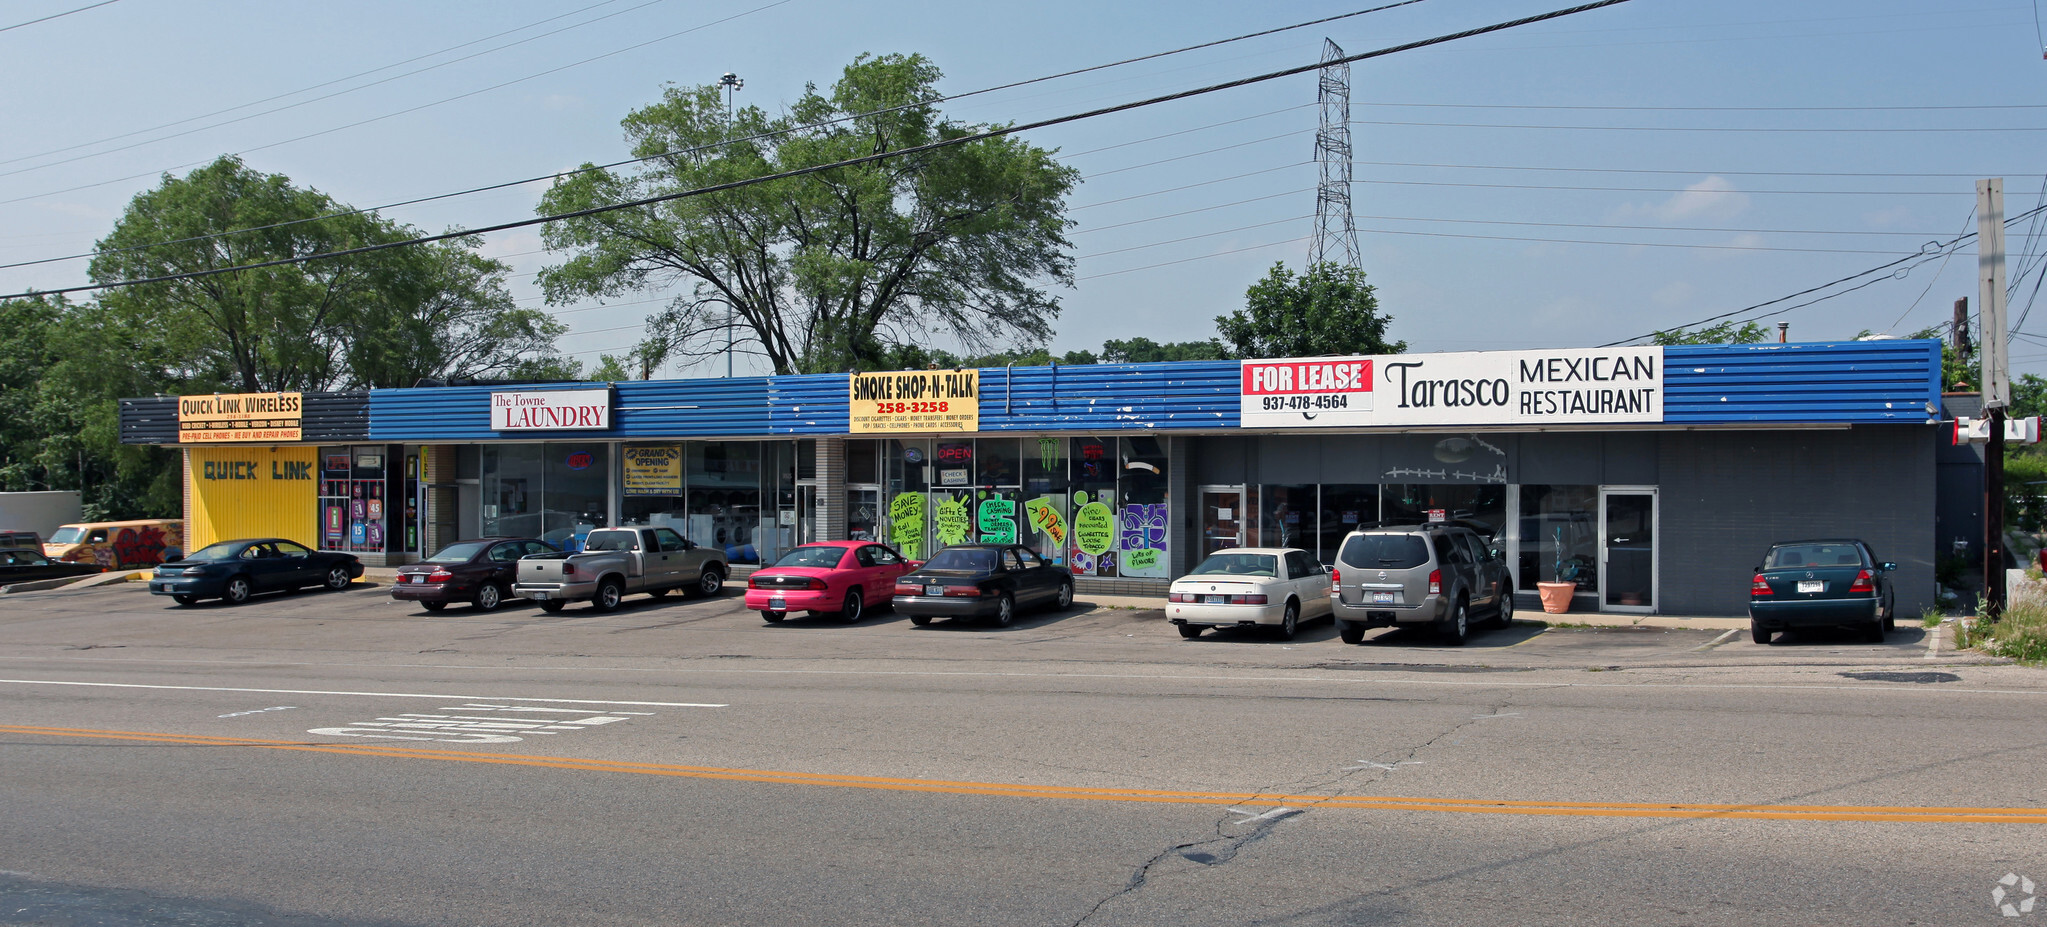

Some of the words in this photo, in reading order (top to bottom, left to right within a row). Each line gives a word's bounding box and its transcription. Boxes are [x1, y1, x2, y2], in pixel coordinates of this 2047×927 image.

[1252, 366, 1293, 392] FOR
[1298, 363, 1362, 391] LEASE
[1520, 355, 1654, 383] MEXICAN
[853, 376, 892, 401] SMOKE
[1384, 360, 1510, 409] Tarasco
[182, 399, 213, 416] QUICK
[217, 398, 241, 414] LINK
[245, 397, 299, 413] WIRELESS
[494, 394, 511, 407] The
[512, 393, 546, 406] Towne
[877, 401, 949, 414] 258-3258
[1262, 394, 1348, 411] 937-478-4564
[1520, 388, 1655, 415] RESTAURANT
[505, 405, 606, 428] LAUNDRY
[182, 432, 202, 440] PRE-PAID
[202, 432, 212, 440] CELL
[213, 431, 230, 440] PHONES
[234, 431, 242, 439] WE
[242, 431, 251, 439] BUY
[252, 431, 262, 439] AND
[263, 430, 279, 438] REPAIR
[280, 430, 299, 438] PHONES
[635, 457, 669, 466] OPENING
[638, 449, 665, 457] GRAND
[938, 448, 972, 459] OPEN
[204, 461, 258, 480] QUICK
[272, 460, 312, 480] LINK
[893, 495, 918, 511] SAVE
[986, 507, 1012, 515] CASHING
[894, 506, 919, 523] MONEY
